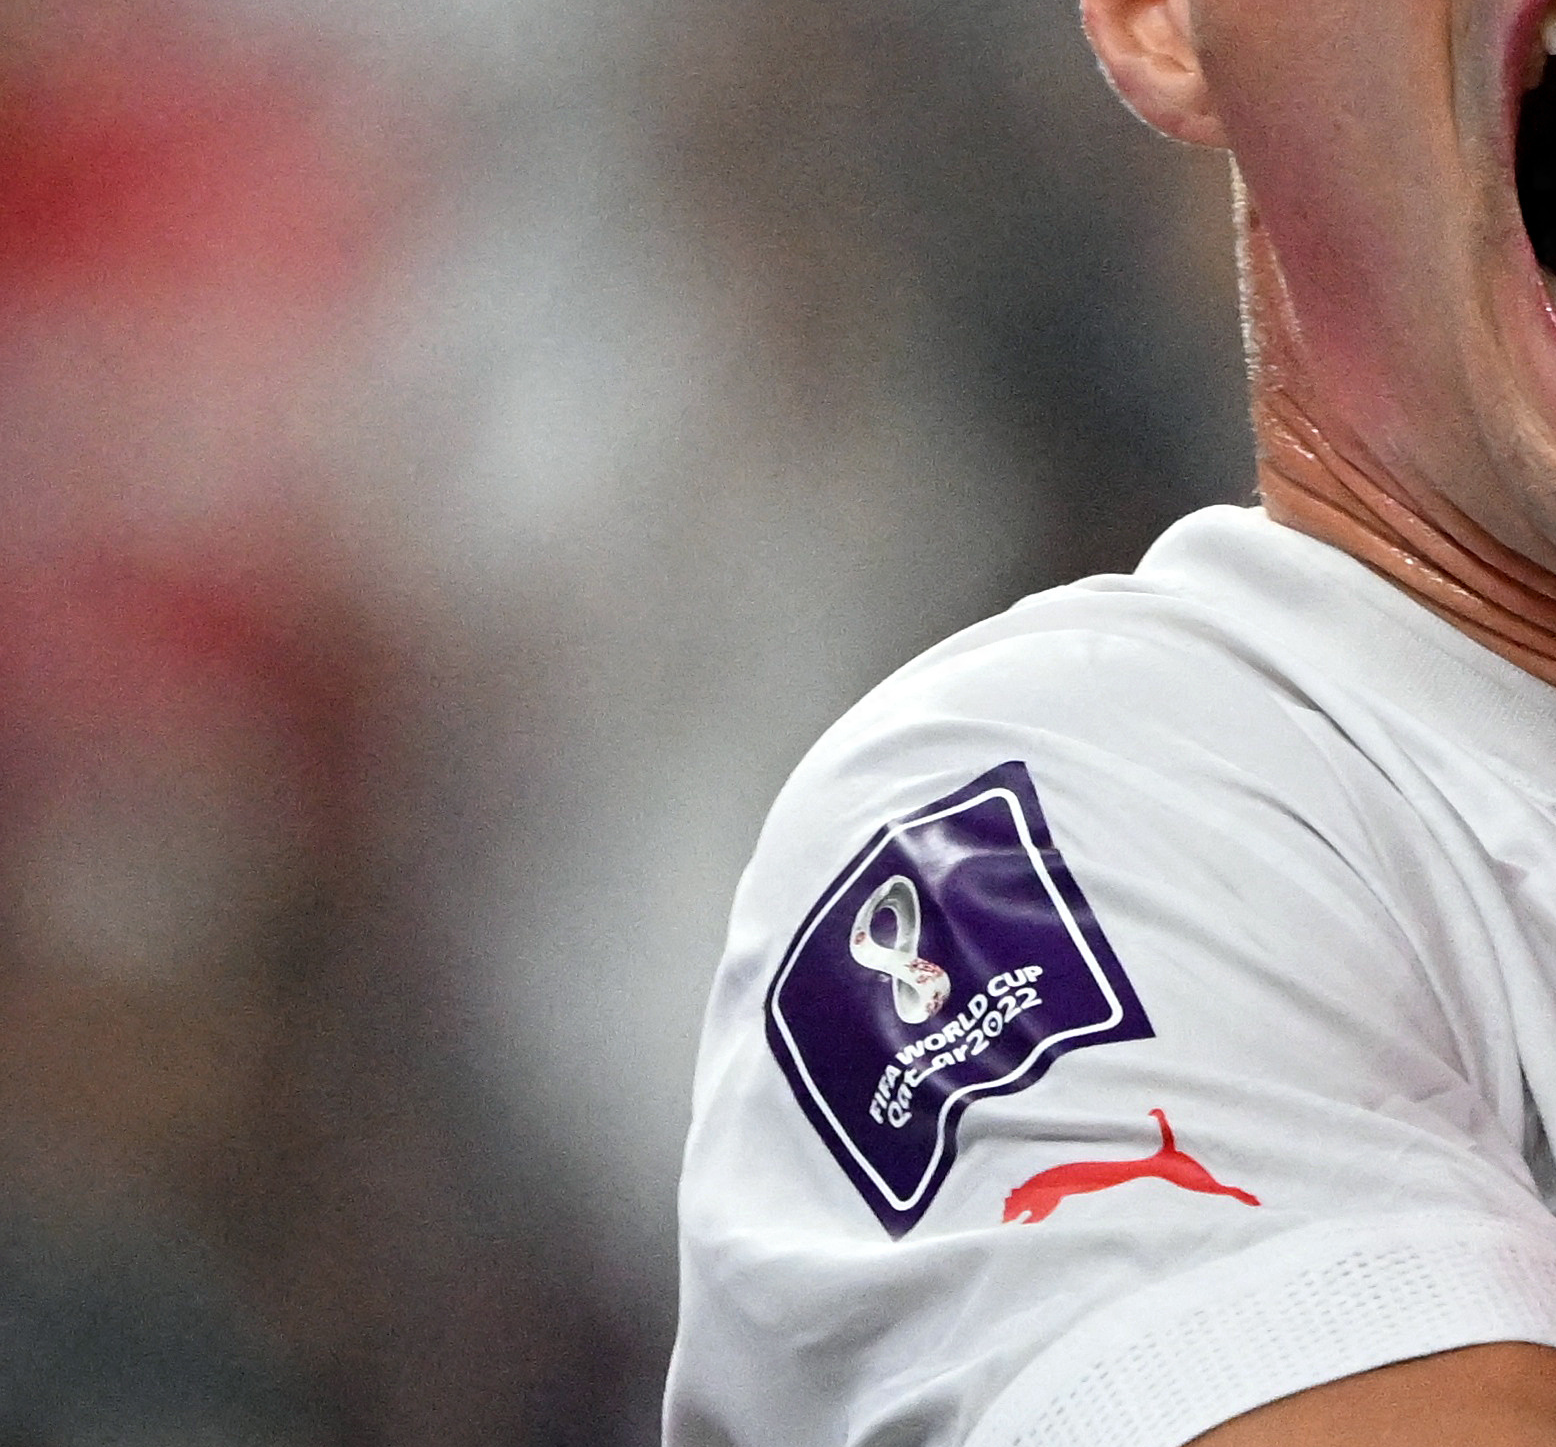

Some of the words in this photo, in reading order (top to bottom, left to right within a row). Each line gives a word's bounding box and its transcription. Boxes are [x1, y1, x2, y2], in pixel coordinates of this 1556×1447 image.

[868, 1064, 902, 1125] FIFA
[894, 993, 989, 1065] WORLD
[986, 965, 1043, 997] CUP
